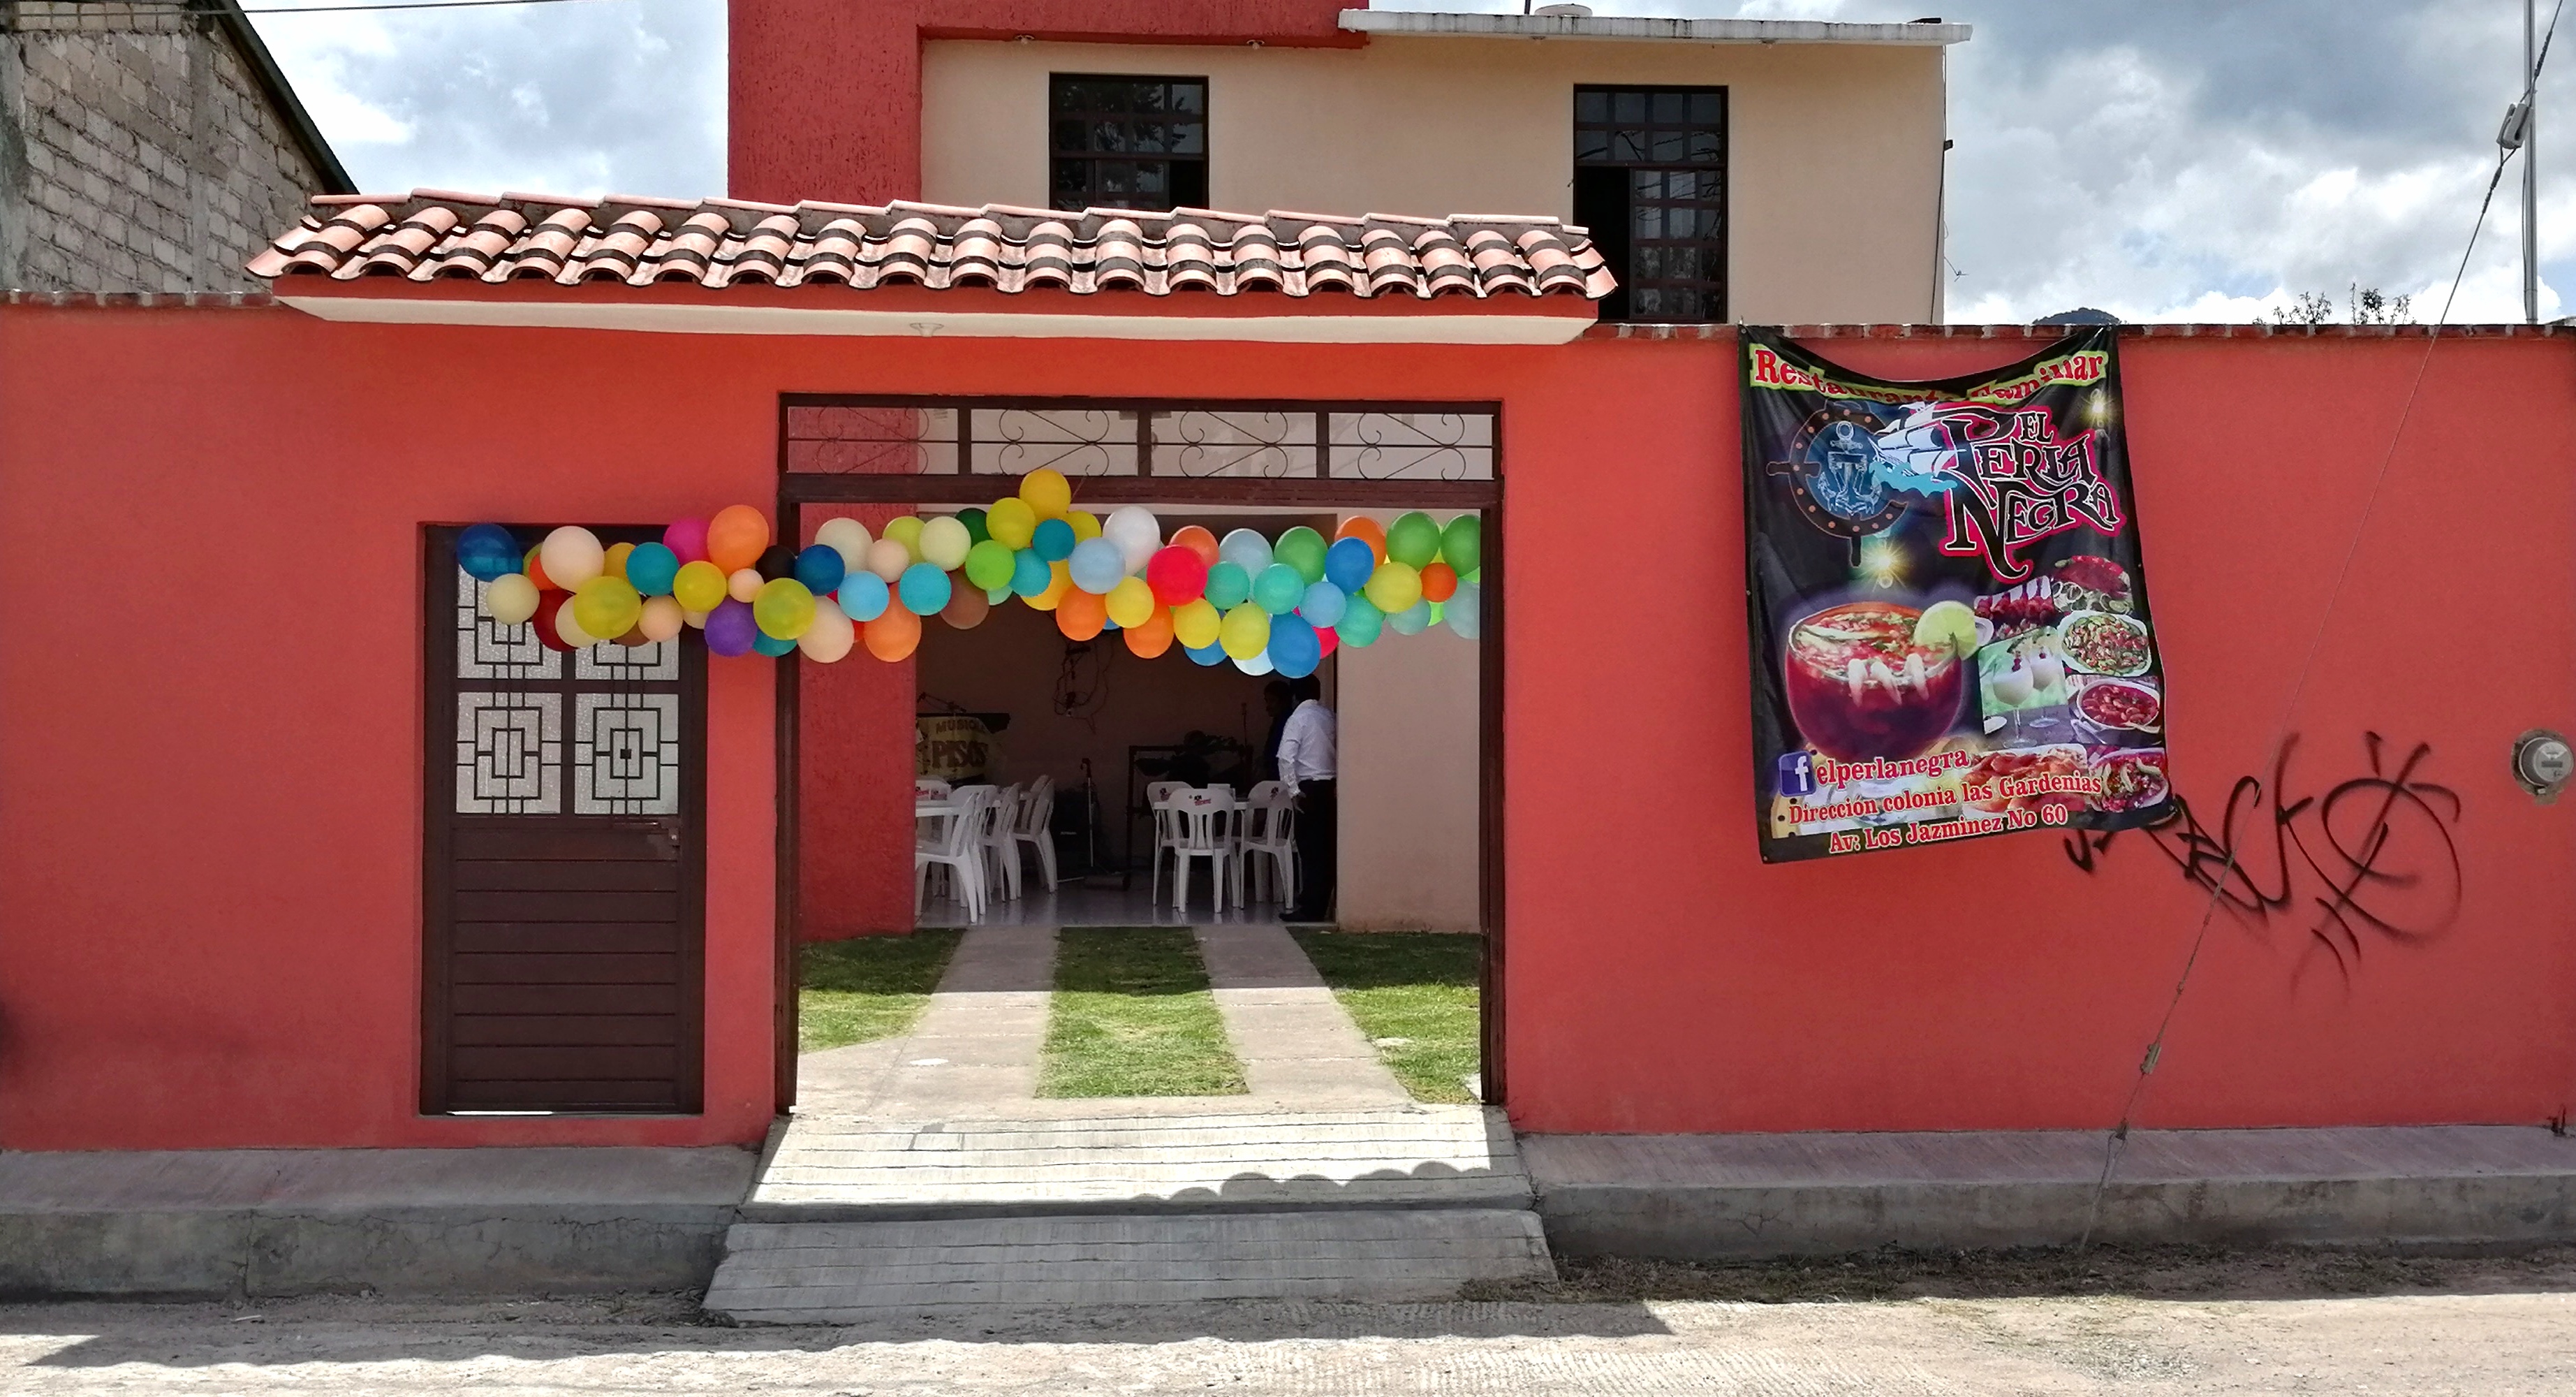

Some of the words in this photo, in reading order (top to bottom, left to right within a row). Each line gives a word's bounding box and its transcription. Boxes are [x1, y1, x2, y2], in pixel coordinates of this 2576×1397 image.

[2017, 410, 2054, 443] EL
[1932, 406, 2098, 509] PERLA
[1933, 469, 2120, 579] NEGRA
[1816, 749, 1969, 790] elperlanegra
[1789, 795, 1878, 824] Dirección
[1883, 786, 1956, 811] colonia
[1962, 783, 1992, 802] las
[1999, 770, 2102, 797] Gardenias
[1830, 832, 1860, 852] Av:
[1864, 827, 1901, 847] Los
[1907, 815, 2003, 843] Jazminez
[2007, 810, 2036, 828] No
[2042, 805, 2067, 824] 60
